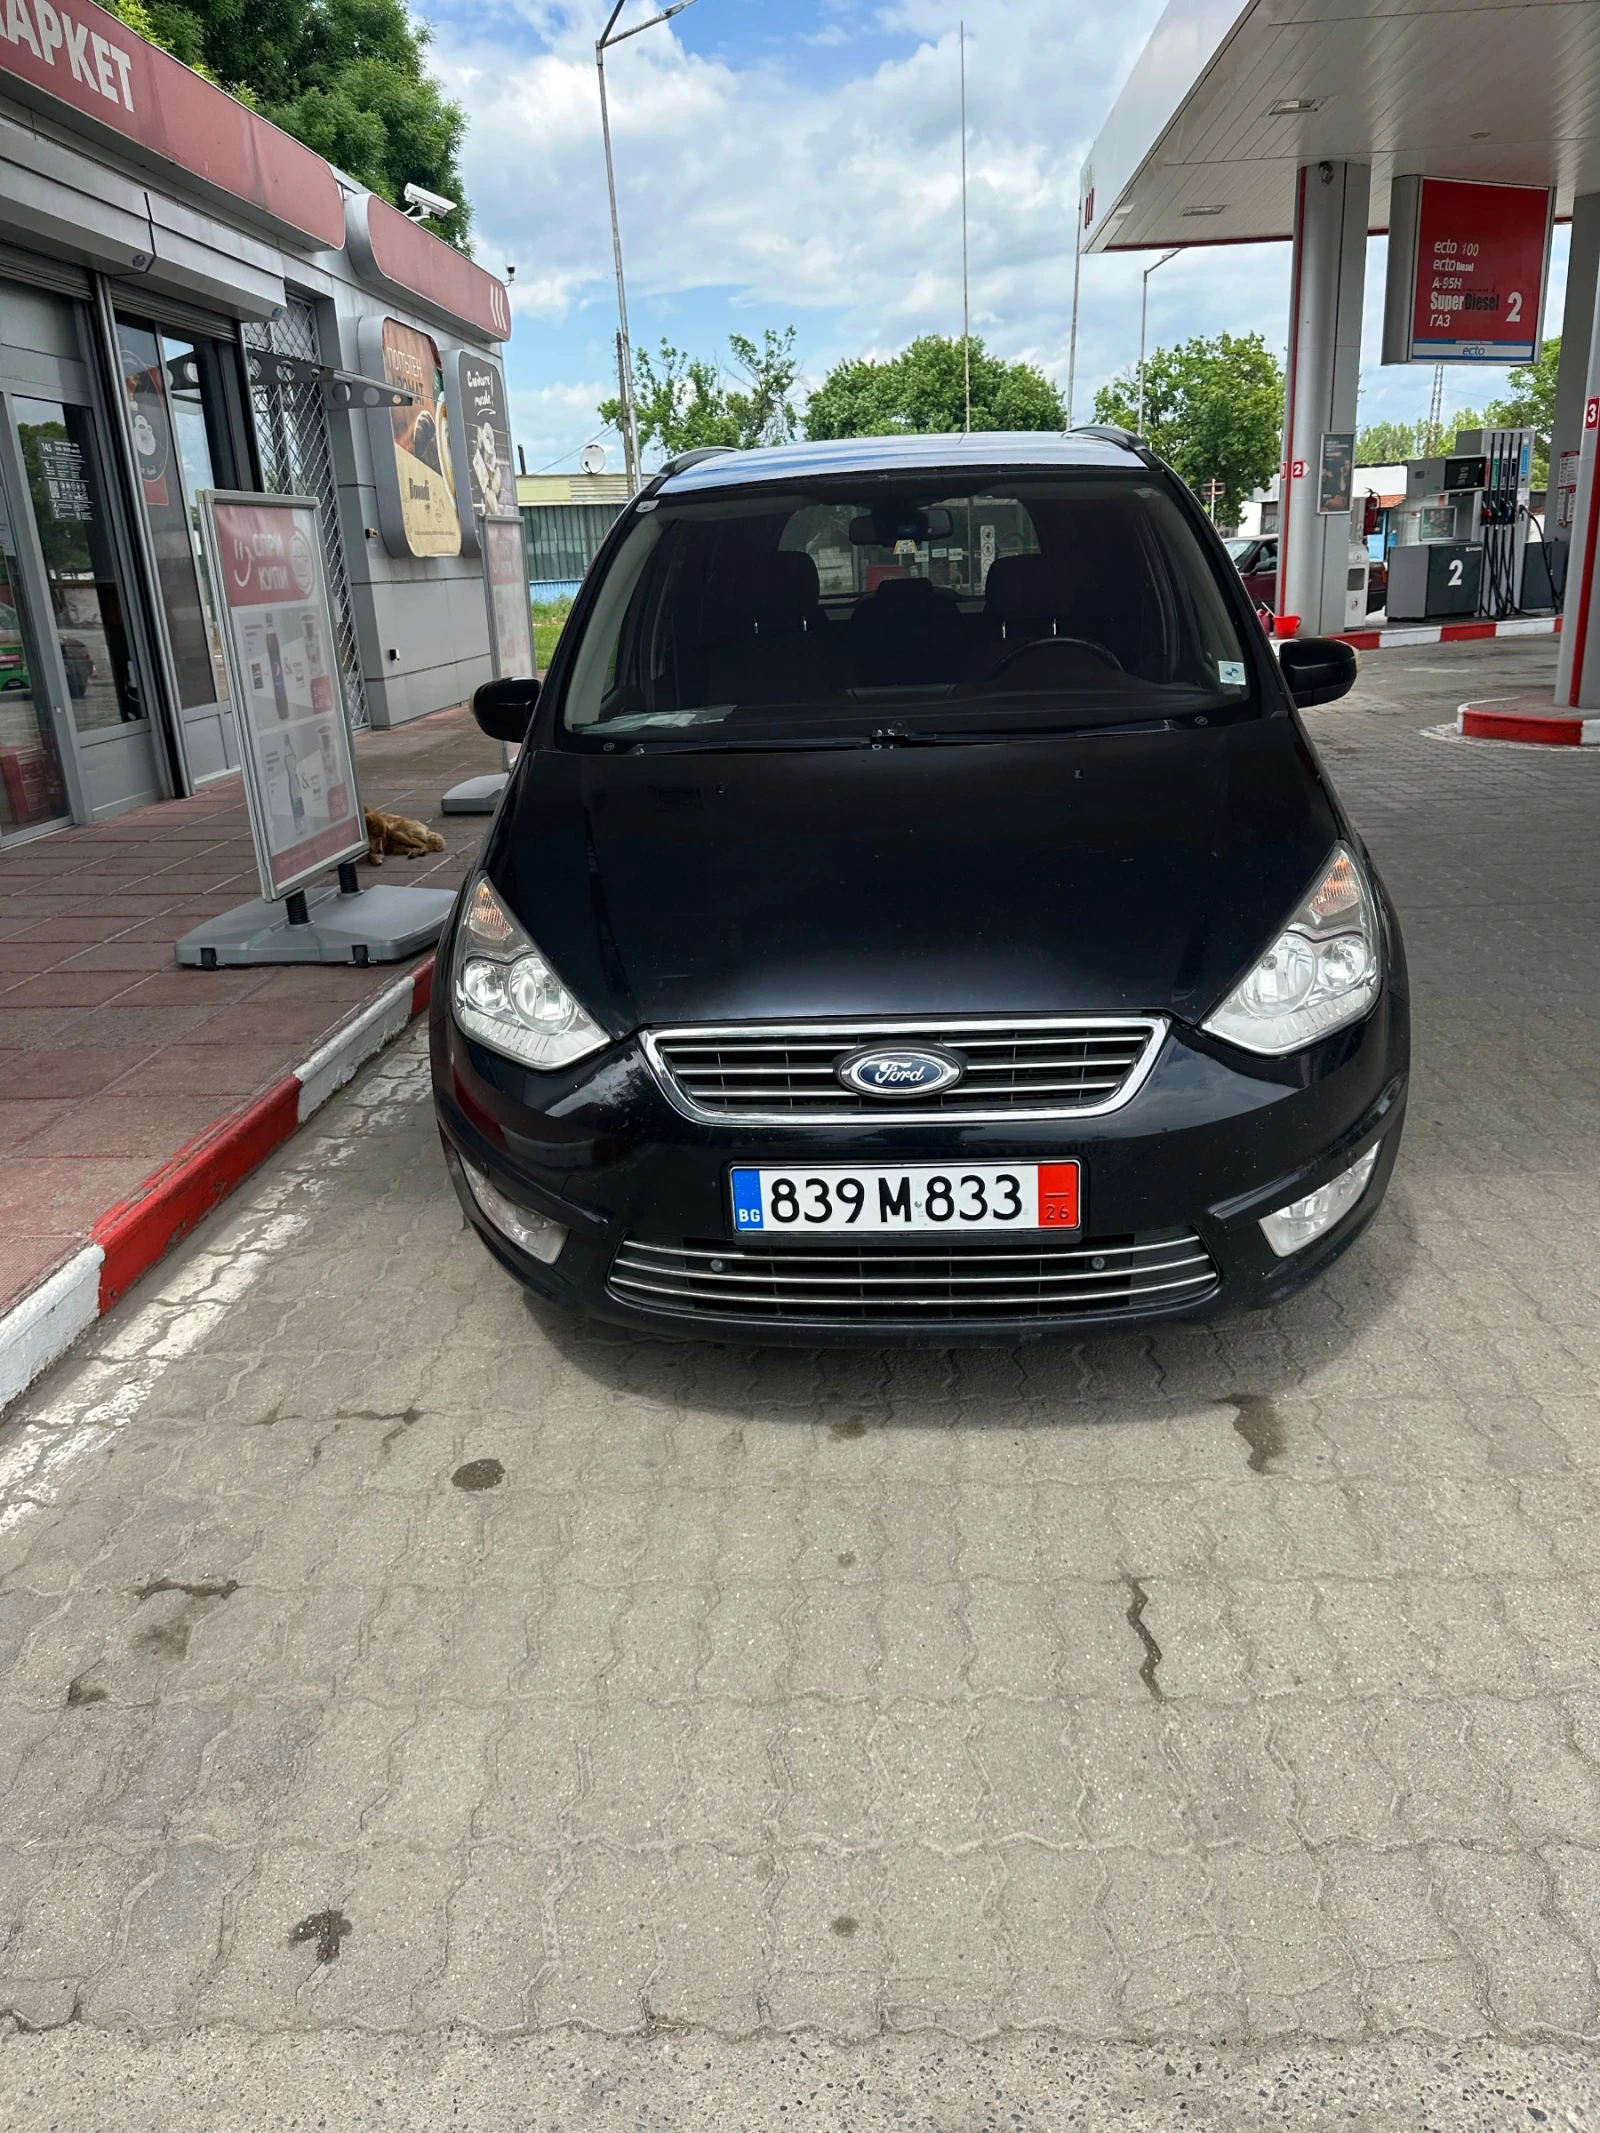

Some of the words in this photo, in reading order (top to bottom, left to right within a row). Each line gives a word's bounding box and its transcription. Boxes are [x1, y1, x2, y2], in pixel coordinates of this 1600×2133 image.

[1434, 239, 1458, 254] ecto
[1462, 243, 1480, 257] 100
[1506, 291, 1523, 322] 2
[1429, 314, 1451, 327] ГАЗ
[1462, 345, 1485, 356] ecto
[387, 347, 423, 379] ПОПЪТЕН
[1587, 403, 1597, 423] 3
[1294, 464, 1302, 475] 2
[252, 532, 285, 557] СПРИ
[258, 566, 289, 591] КУПИ
[1447, 559, 1463, 586] 2
[874, 1062, 925, 1085] Ford
[771, 1177, 865, 1224] 839
[877, 1176, 912, 1223] M
[925, 1173, 1023, 1223] 833
[738, 1207, 761, 1223] BG
[1045, 1204, 1069, 1221] 26
